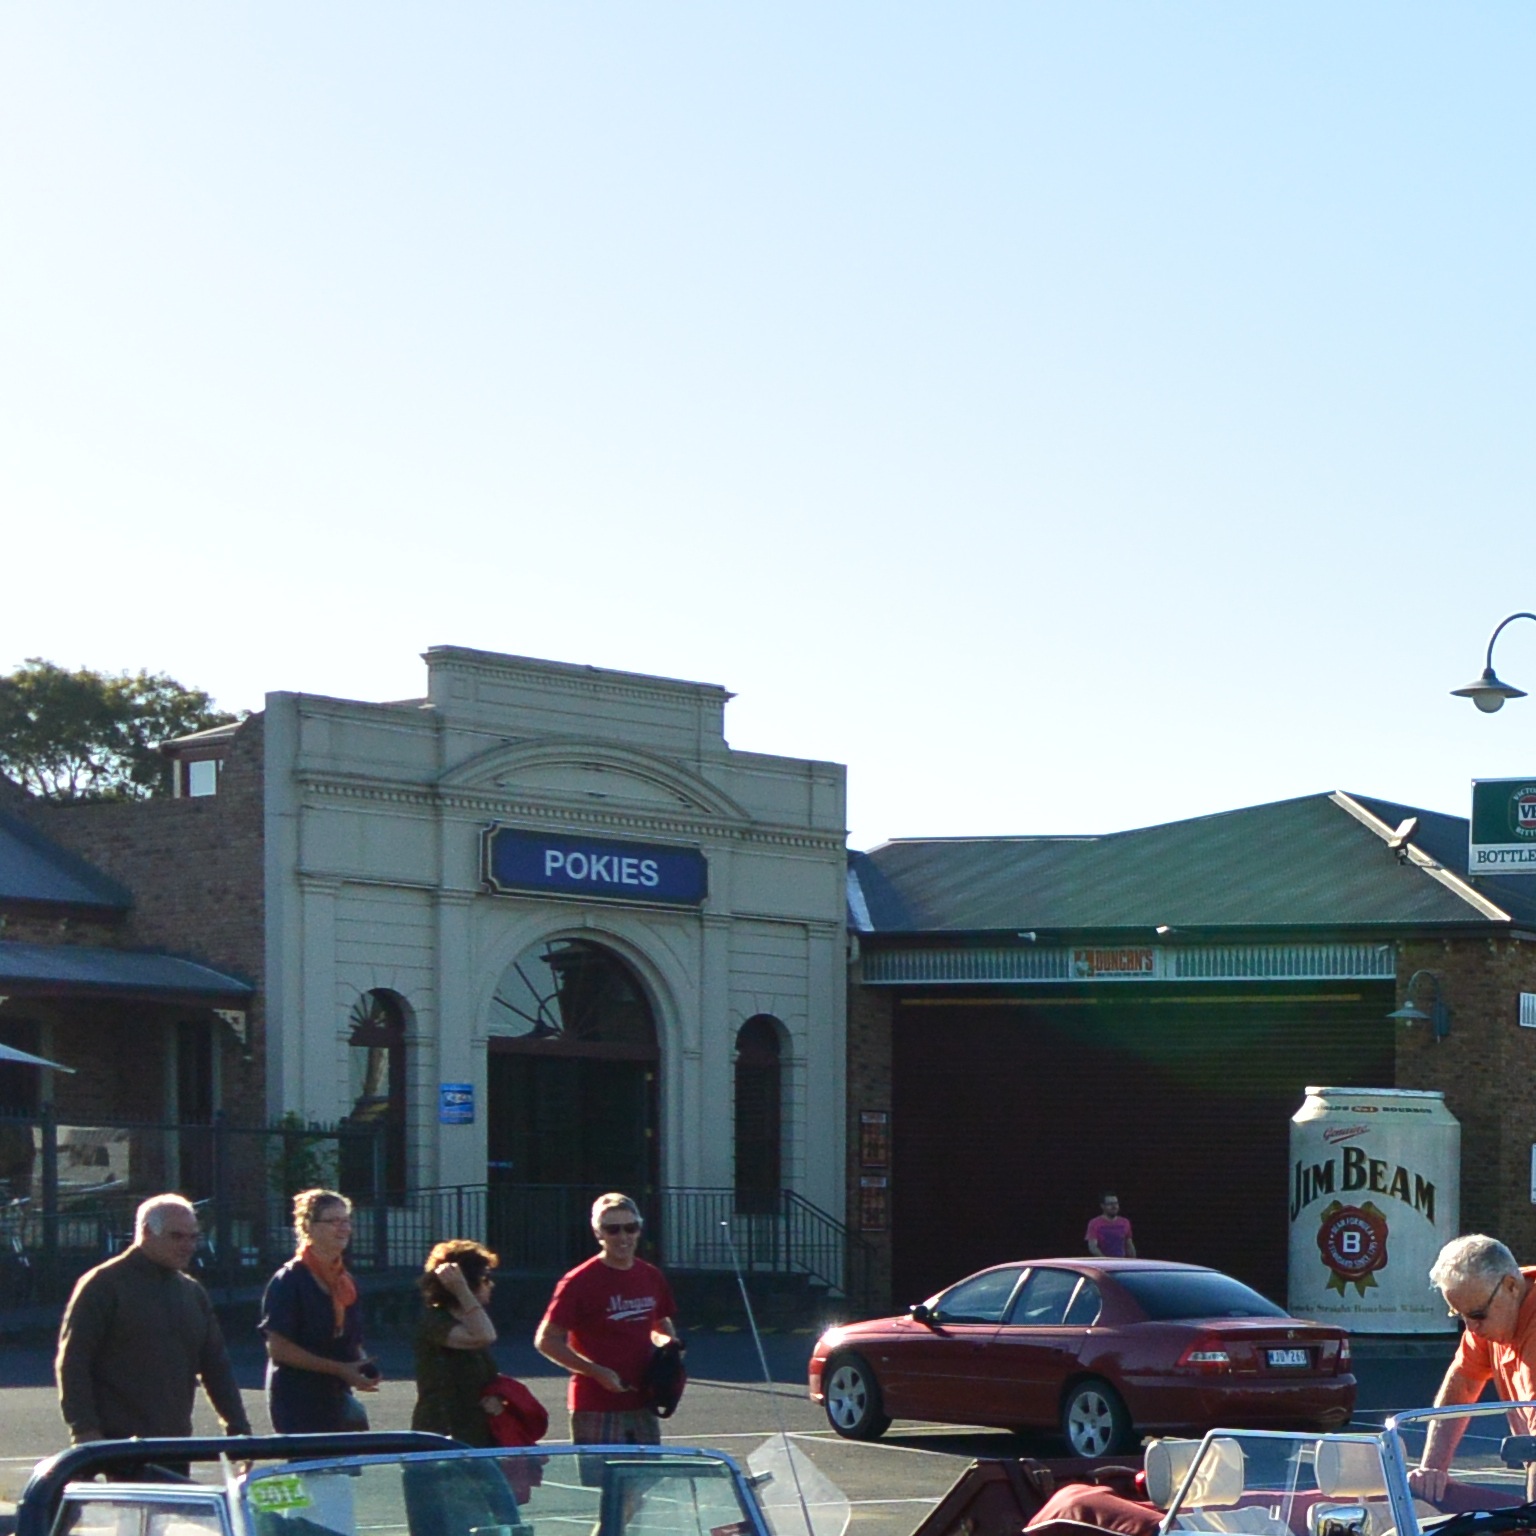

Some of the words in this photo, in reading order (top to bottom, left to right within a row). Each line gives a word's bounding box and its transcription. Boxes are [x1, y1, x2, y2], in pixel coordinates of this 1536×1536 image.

[545, 850, 659, 887] POKIES
[1476, 849, 1536, 863] BOTTLE
[1290, 1159, 1335, 1222] JIM
[1341, 1146, 1435, 1226] BEAM
[1343, 1232, 1360, 1253] B
